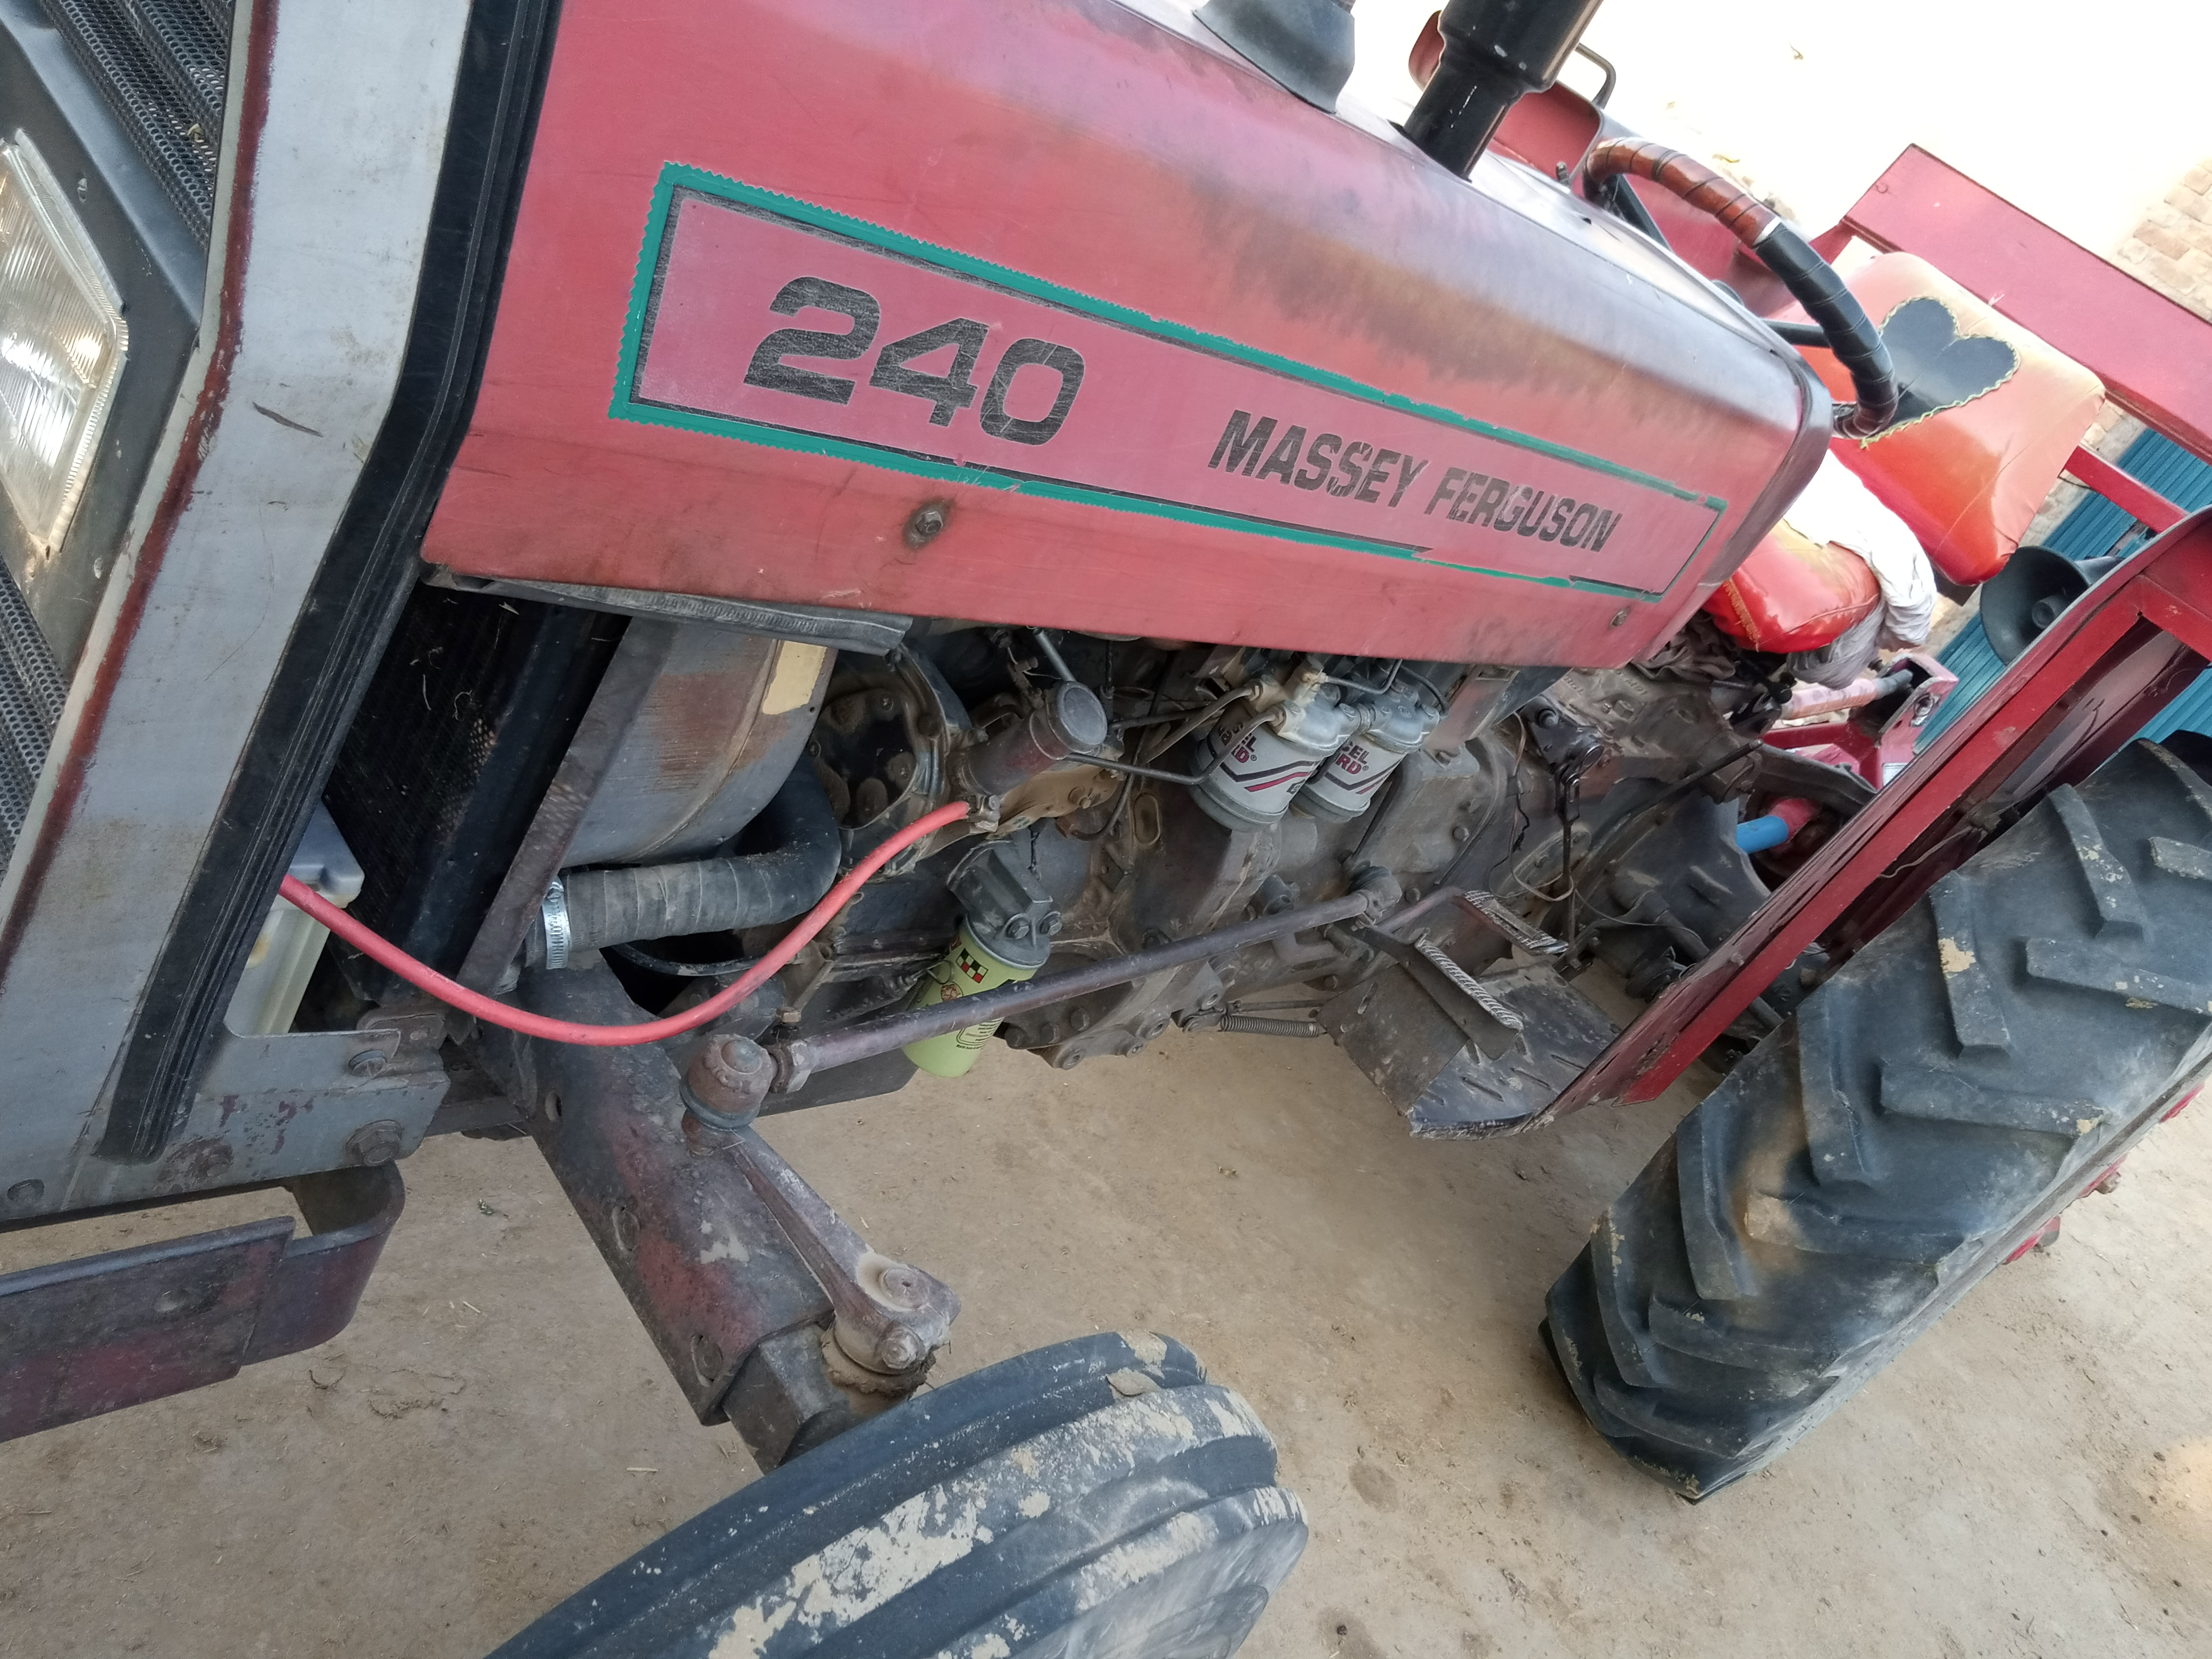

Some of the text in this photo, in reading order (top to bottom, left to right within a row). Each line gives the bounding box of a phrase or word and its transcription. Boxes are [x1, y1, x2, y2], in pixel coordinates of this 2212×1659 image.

[743, 276, 1085, 446] 240
[1207, 409, 1623, 553] MASSEY FERGUSON
